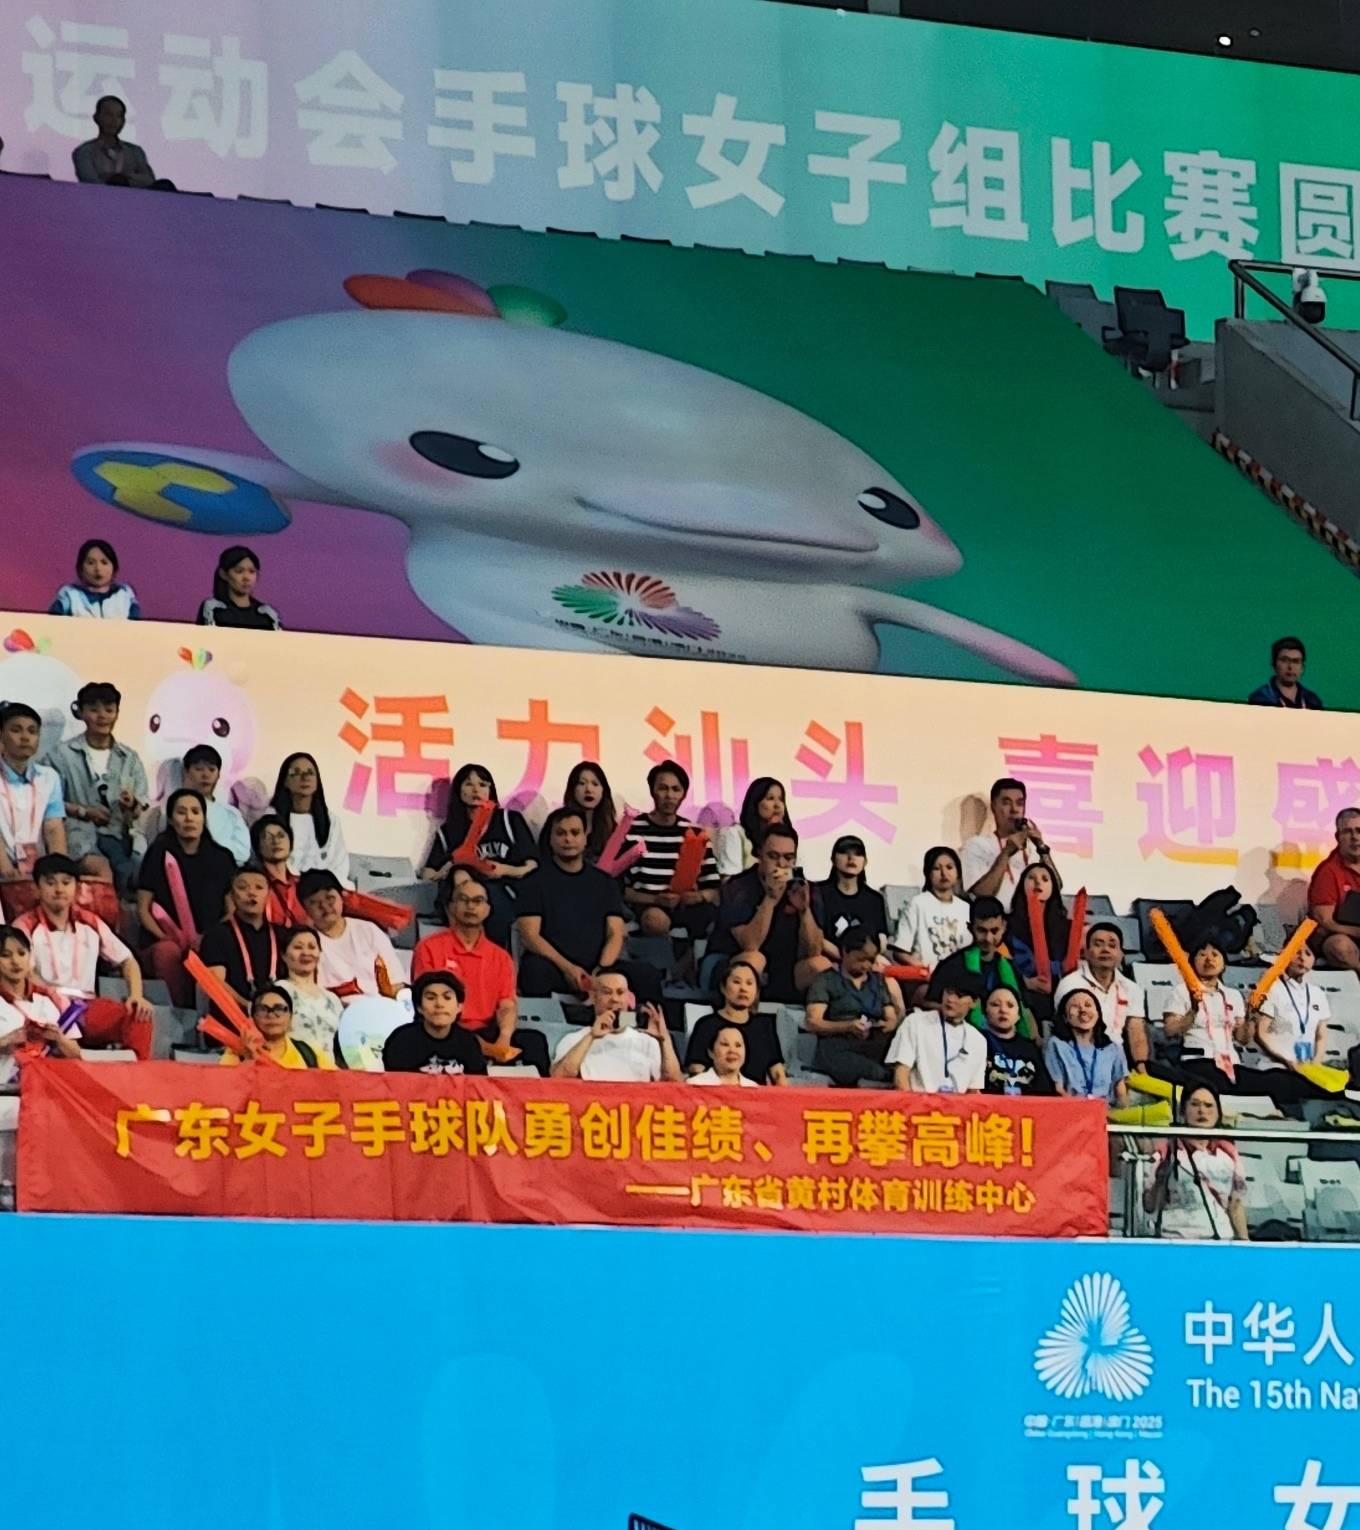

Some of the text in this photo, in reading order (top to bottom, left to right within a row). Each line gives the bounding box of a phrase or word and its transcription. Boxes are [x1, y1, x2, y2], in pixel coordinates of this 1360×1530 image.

[338, 687, 898, 844] 活力汕头
[1186, 1378, 1241, 1409] The
[1250, 1380, 1311, 1410] 15th
